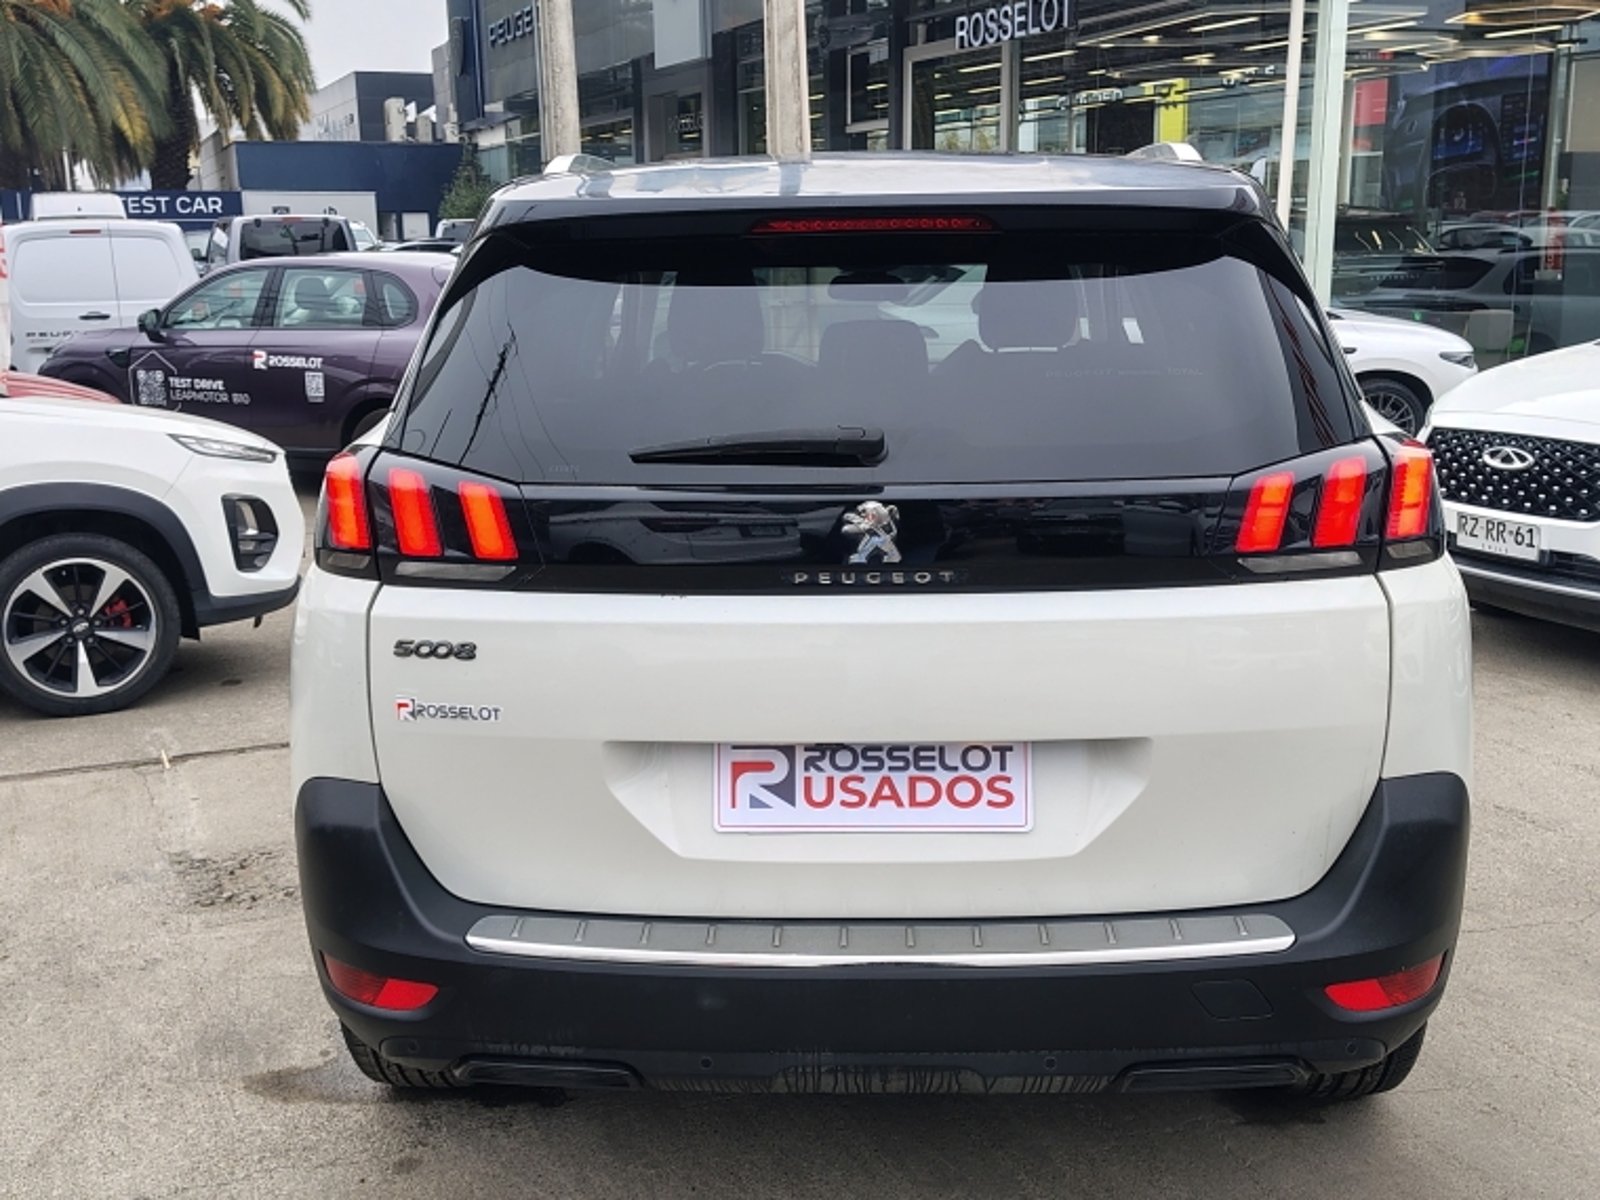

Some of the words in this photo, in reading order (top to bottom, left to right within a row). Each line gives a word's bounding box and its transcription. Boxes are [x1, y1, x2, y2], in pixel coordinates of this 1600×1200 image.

[488, 6, 533, 48] PEUGE
[176, 196, 223, 214] CAR
[268, 355, 323, 369] ROSSELOT
[168, 376, 192, 389] TEST
[192, 378, 226, 391] DRIVE
[794, 571, 955, 584] PEUGEOT
[393, 639, 477, 661] 5008
[417, 703, 501, 720] ROSSELOT
[803, 744, 1014, 773] ROSSELOT
[803, 775, 1015, 809] USADOS
